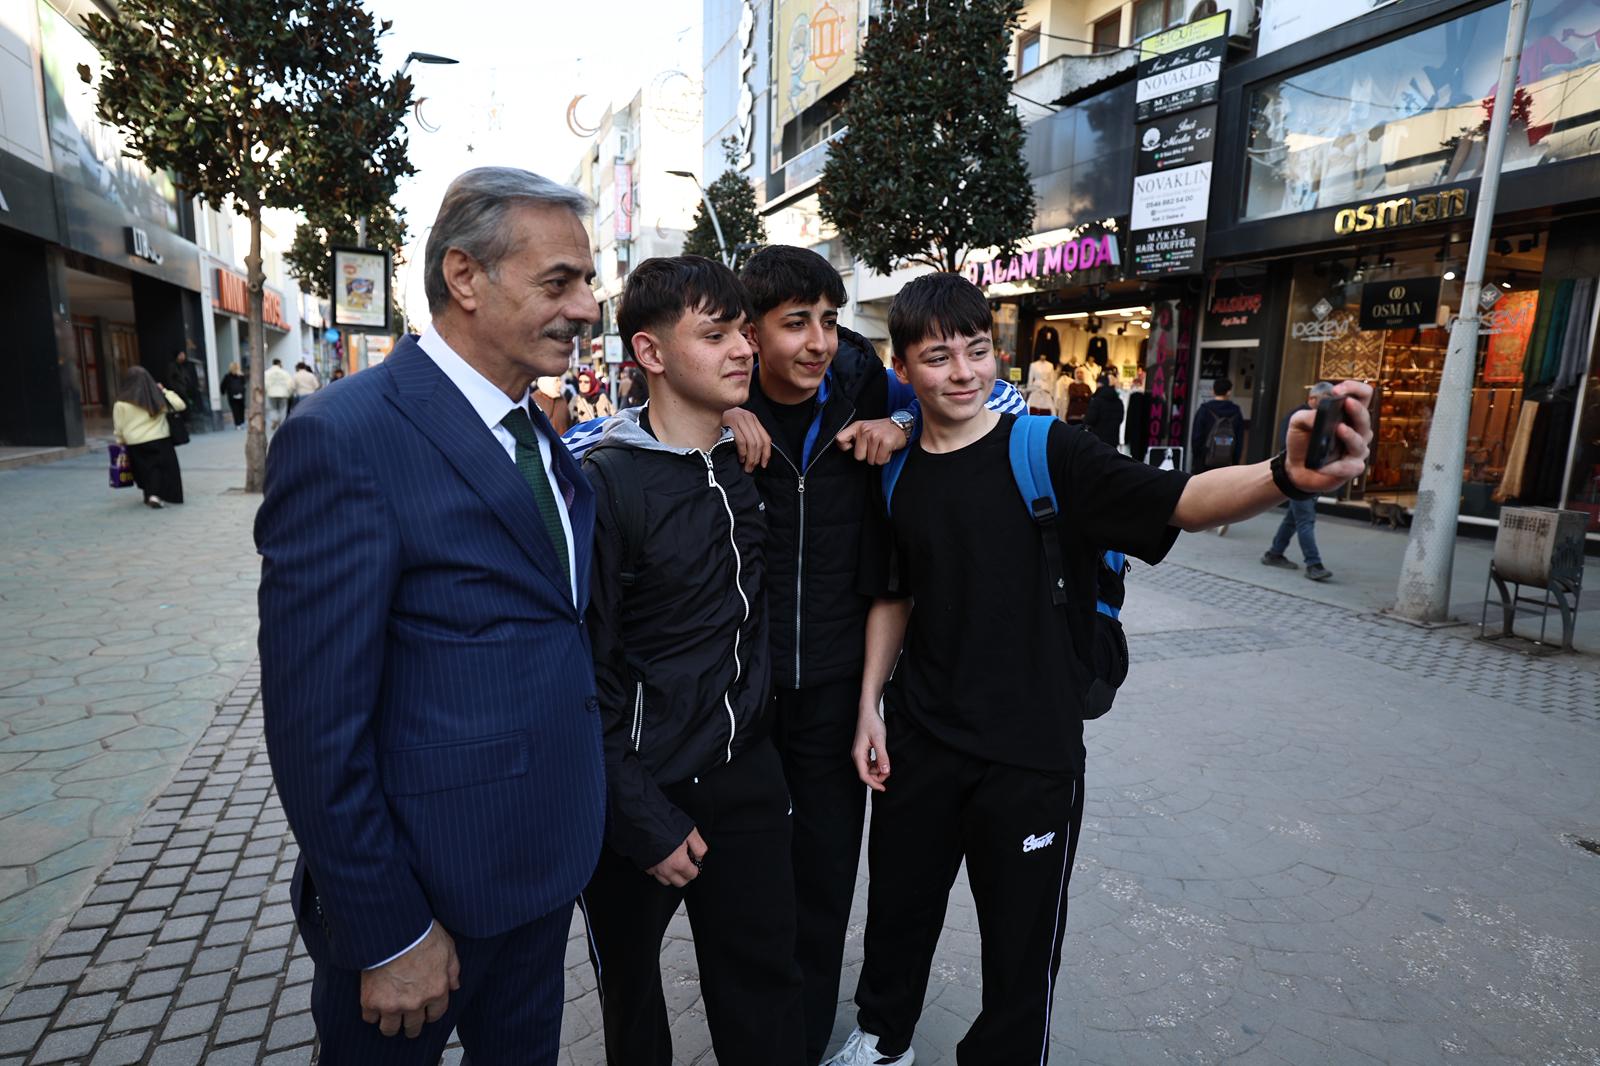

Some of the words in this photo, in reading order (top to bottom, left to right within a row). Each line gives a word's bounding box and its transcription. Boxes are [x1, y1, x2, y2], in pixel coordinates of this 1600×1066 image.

[1144, 62, 1214, 92] NOVAKLIN
[1136, 168, 1210, 195] NOVAKLIN
[1334, 188, 1469, 235] osman
[1043, 234, 1118, 275] MODA
[1136, 242, 1154, 254] HAIR
[1372, 301, 1423, 318] OSMAN
